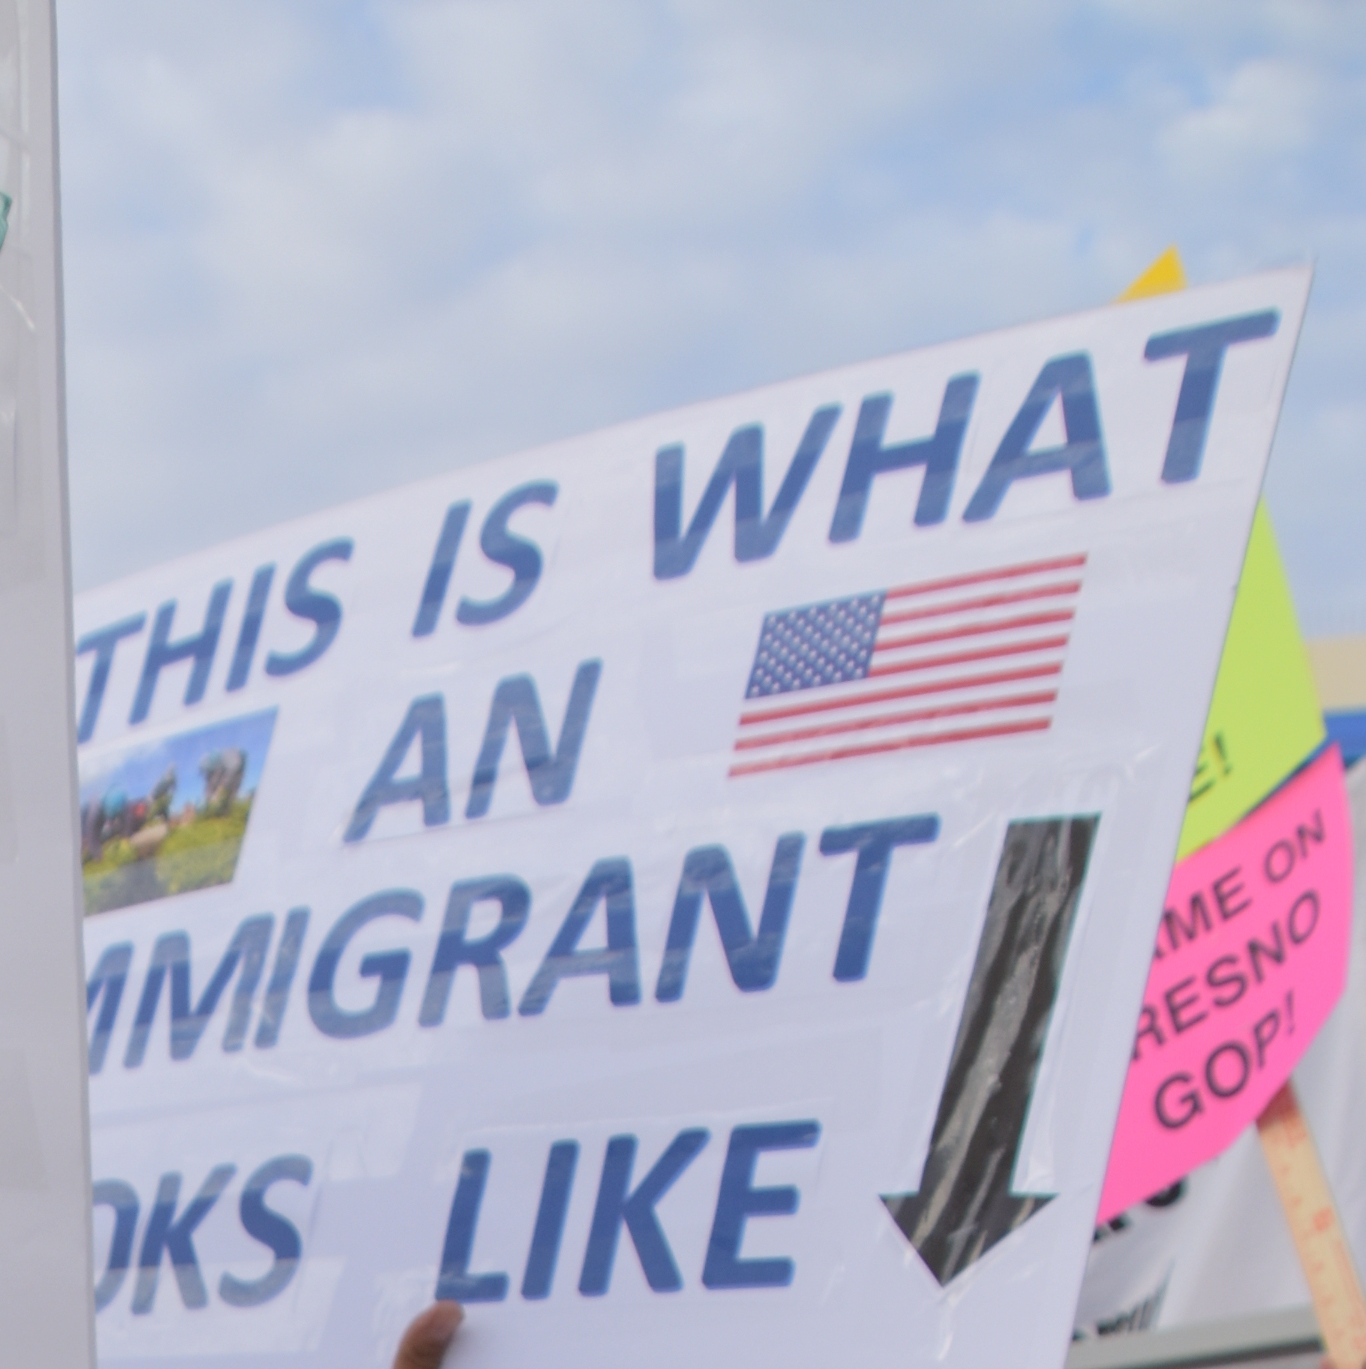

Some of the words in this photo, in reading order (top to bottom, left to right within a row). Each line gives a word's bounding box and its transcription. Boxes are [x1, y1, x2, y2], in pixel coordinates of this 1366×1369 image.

[77, 534, 355, 745] THIS
[411, 479, 560, 637] IS
[652, 307, 1282, 580] WHAT
[342, 658, 604, 844] AN
[1264, 808, 1326, 884] ON
[87, 813, 940, 1076] MIGRANT
[1152, 990, 1296, 1132] GOP!
[434, 1118, 822, 1304] LIKE
